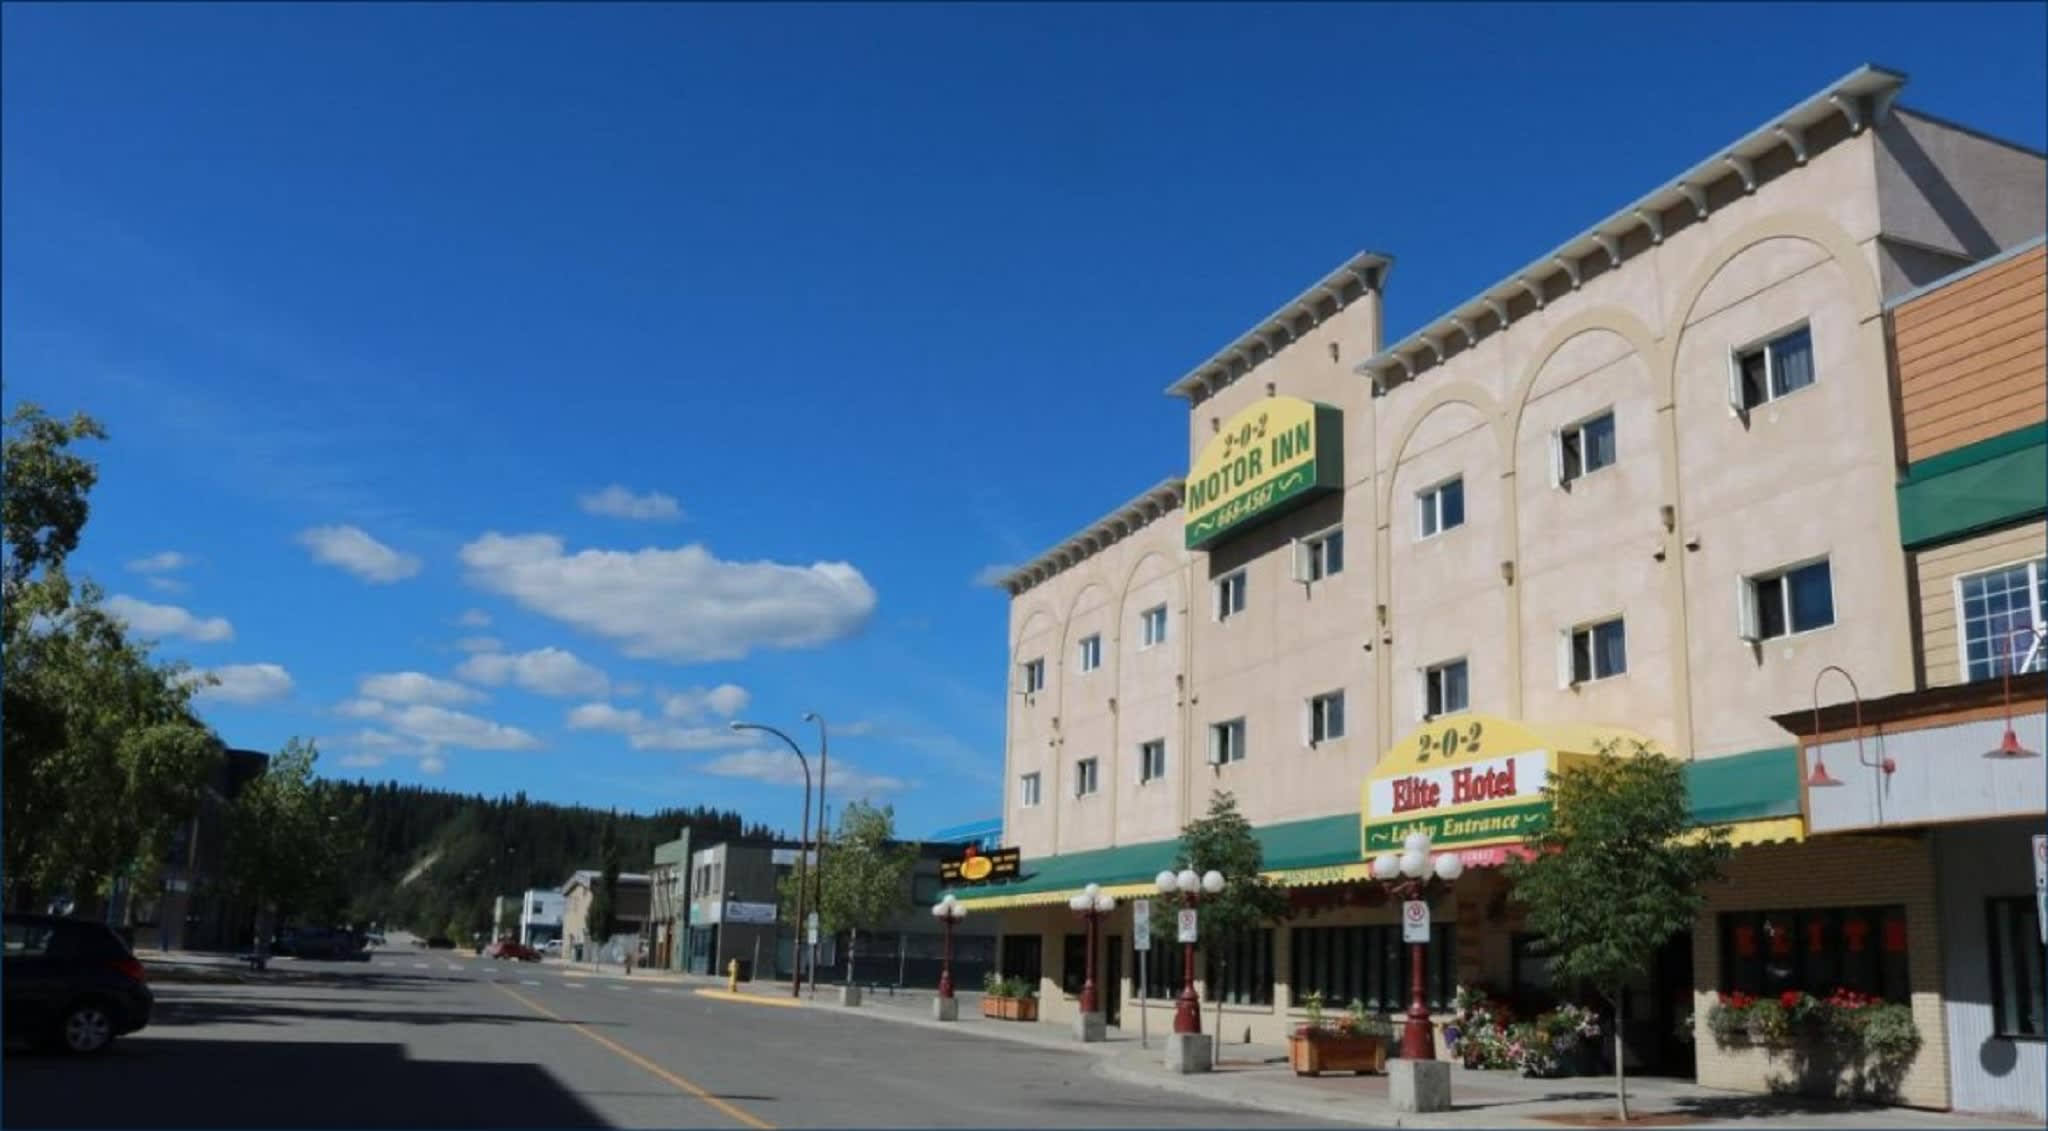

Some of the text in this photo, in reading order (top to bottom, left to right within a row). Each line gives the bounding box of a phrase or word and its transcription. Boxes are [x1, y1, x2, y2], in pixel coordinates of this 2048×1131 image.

[1224, 413, 1268, 459] 2-0-2
[1189, 419, 1311, 514] MOTOR INN
[1416, 722, 1483, 763] 2-0-2
[1391, 758, 1517, 814] Elite Hotel
[1442, 814, 1520, 837] Entrance
